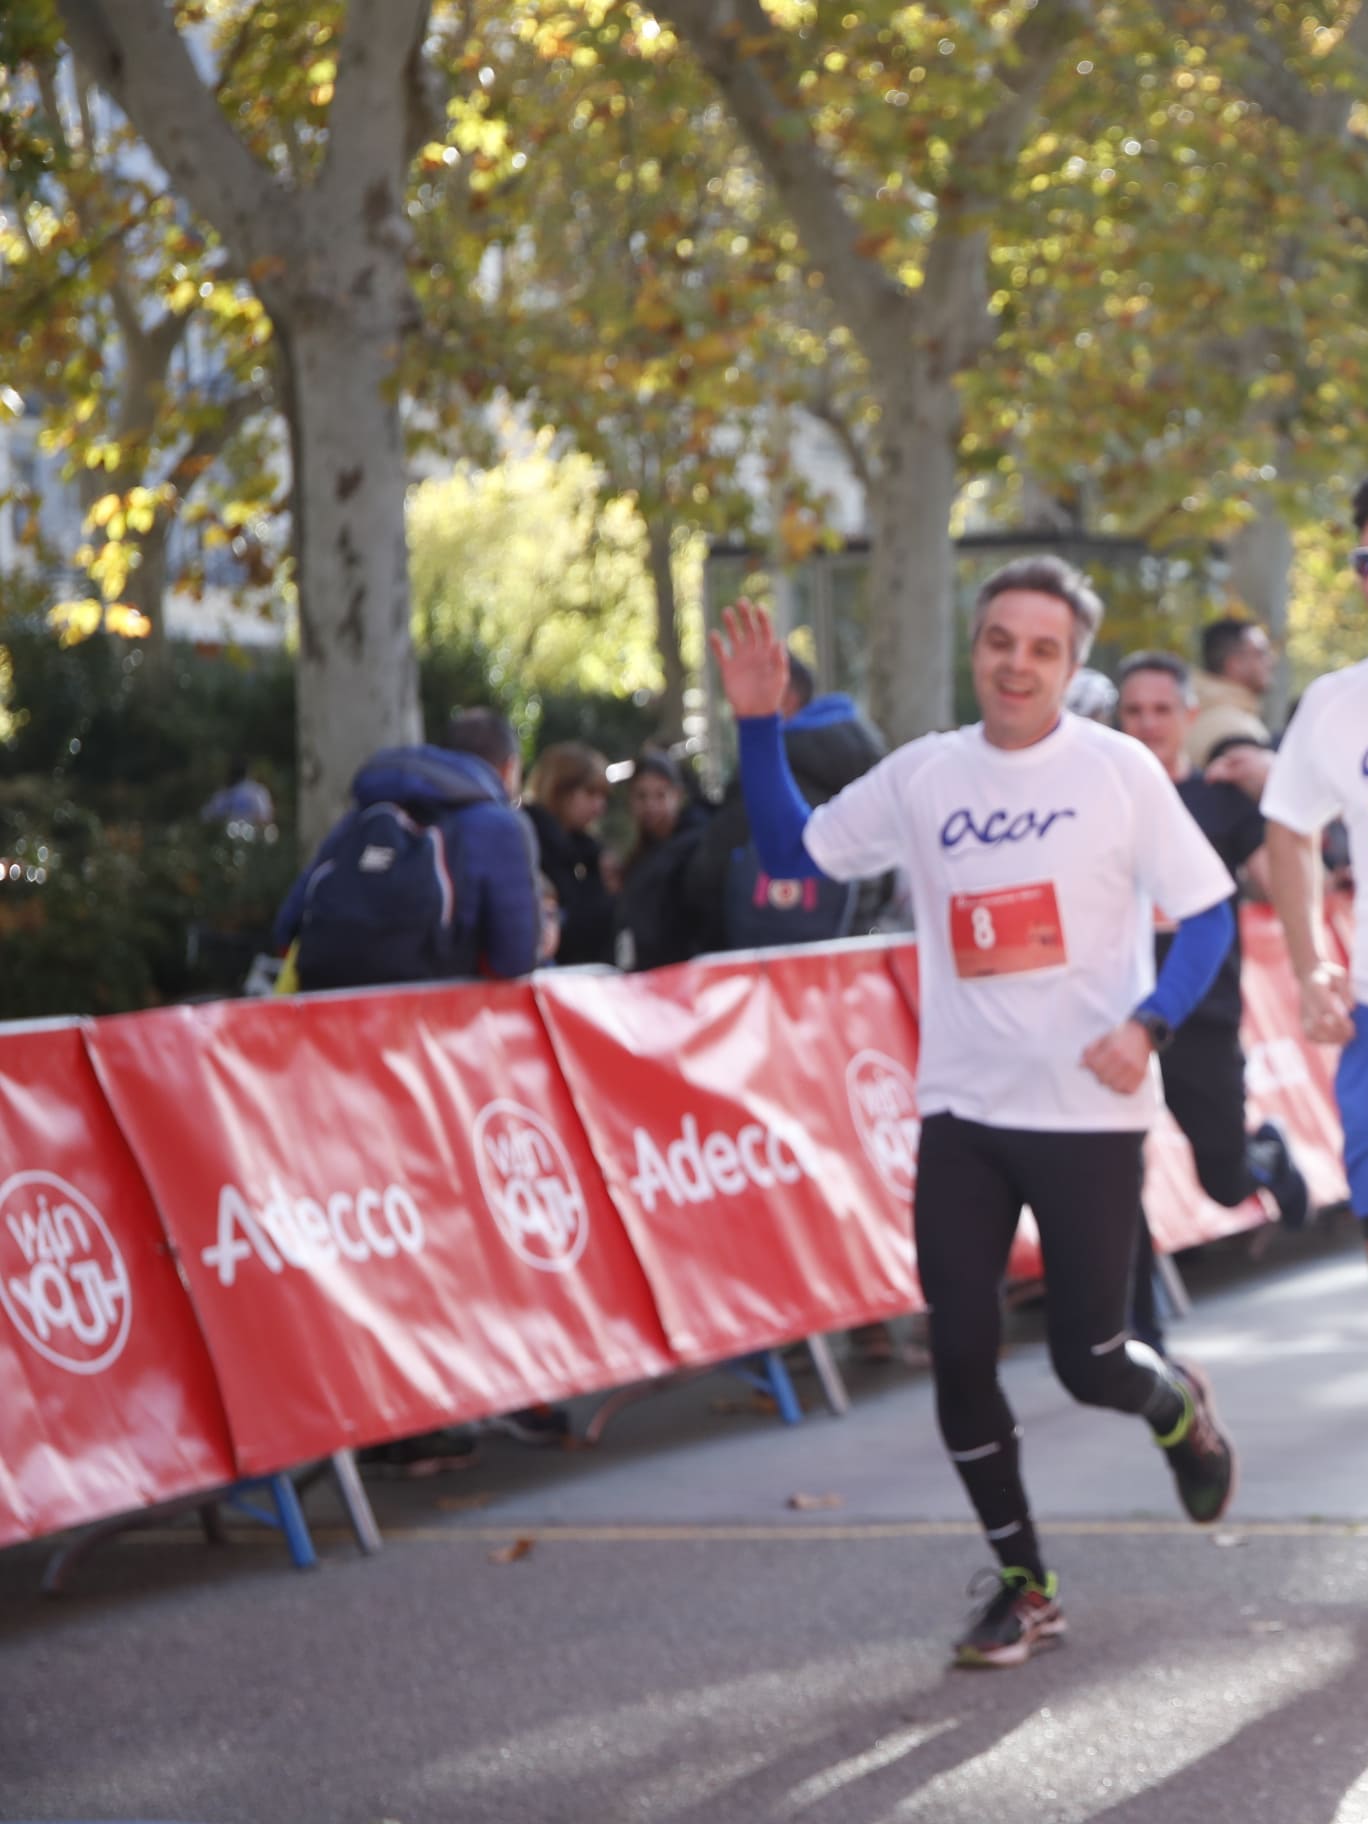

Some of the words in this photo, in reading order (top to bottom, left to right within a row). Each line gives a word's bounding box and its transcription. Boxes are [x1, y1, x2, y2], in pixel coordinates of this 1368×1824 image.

[938, 806, 1077, 848] acor
[970, 904, 997, 950] 8
[201, 1175, 424, 1287] Adecco
[8, 1252, 126, 1346] YOUTH
